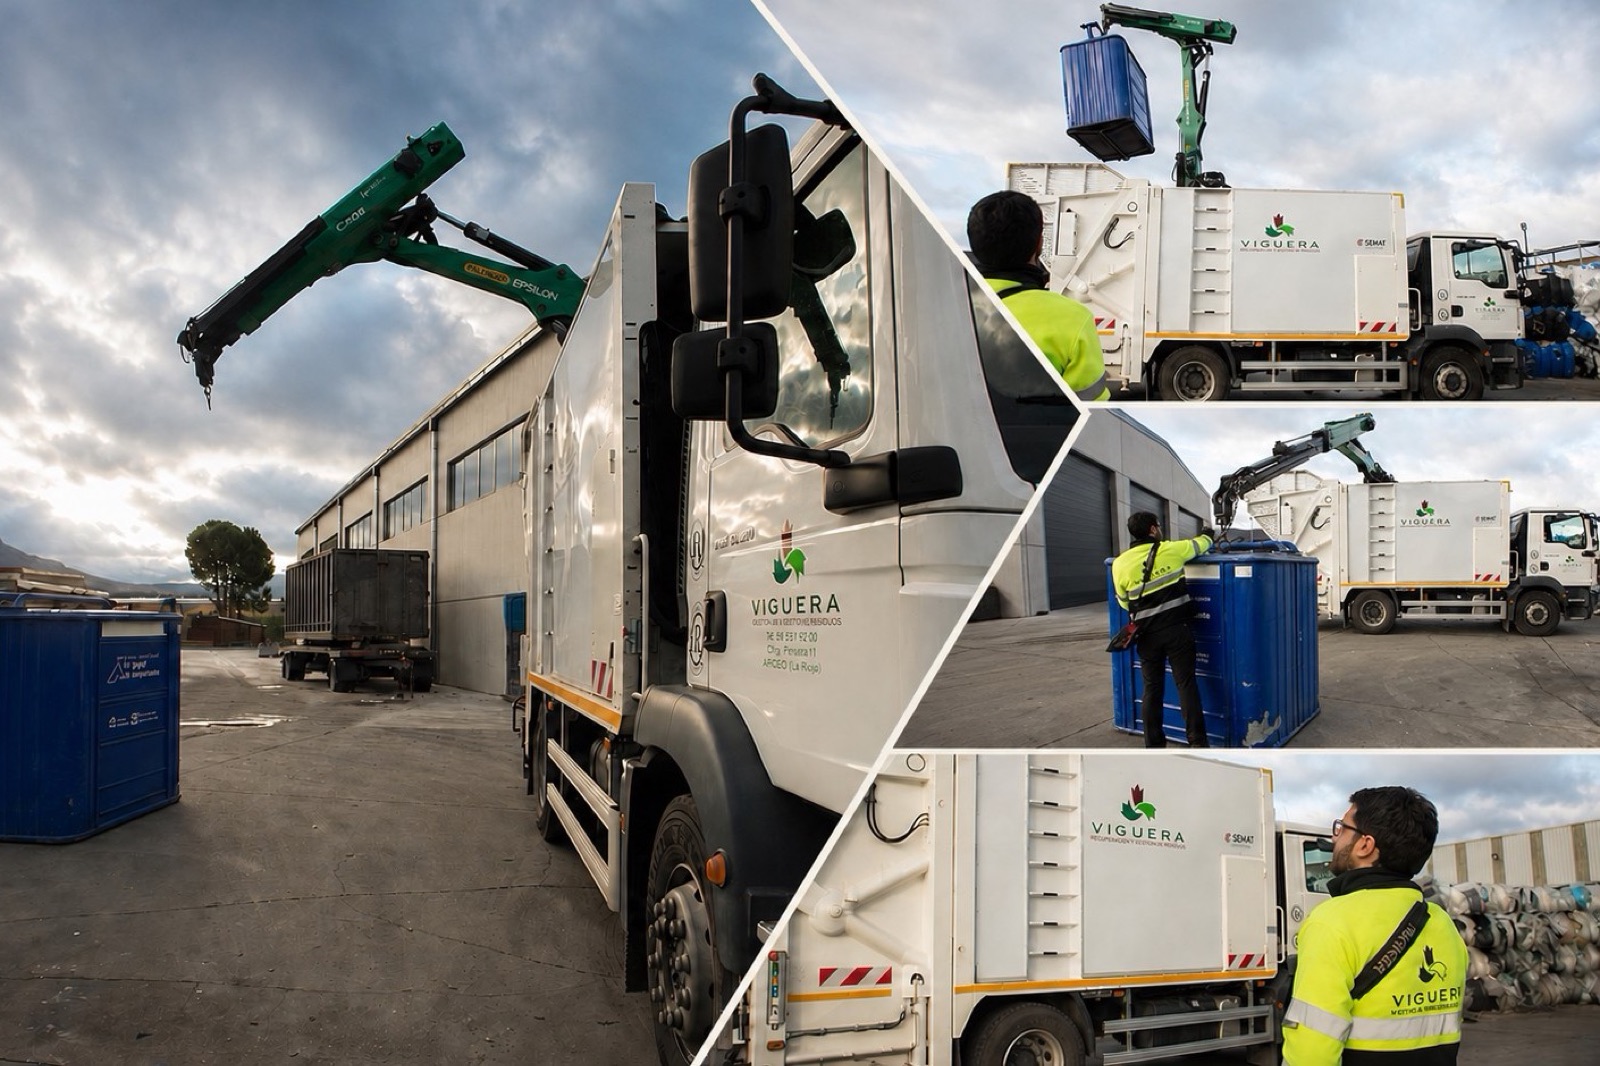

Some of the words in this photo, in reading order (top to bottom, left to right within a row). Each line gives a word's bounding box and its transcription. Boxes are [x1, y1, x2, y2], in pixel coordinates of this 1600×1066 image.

[1240, 240, 1320, 249] VIGUERA
[512, 278, 559, 301] EPSILON
[751, 593, 840, 616] VIGUERA
[1092, 821, 1185, 843] VIGUERA
